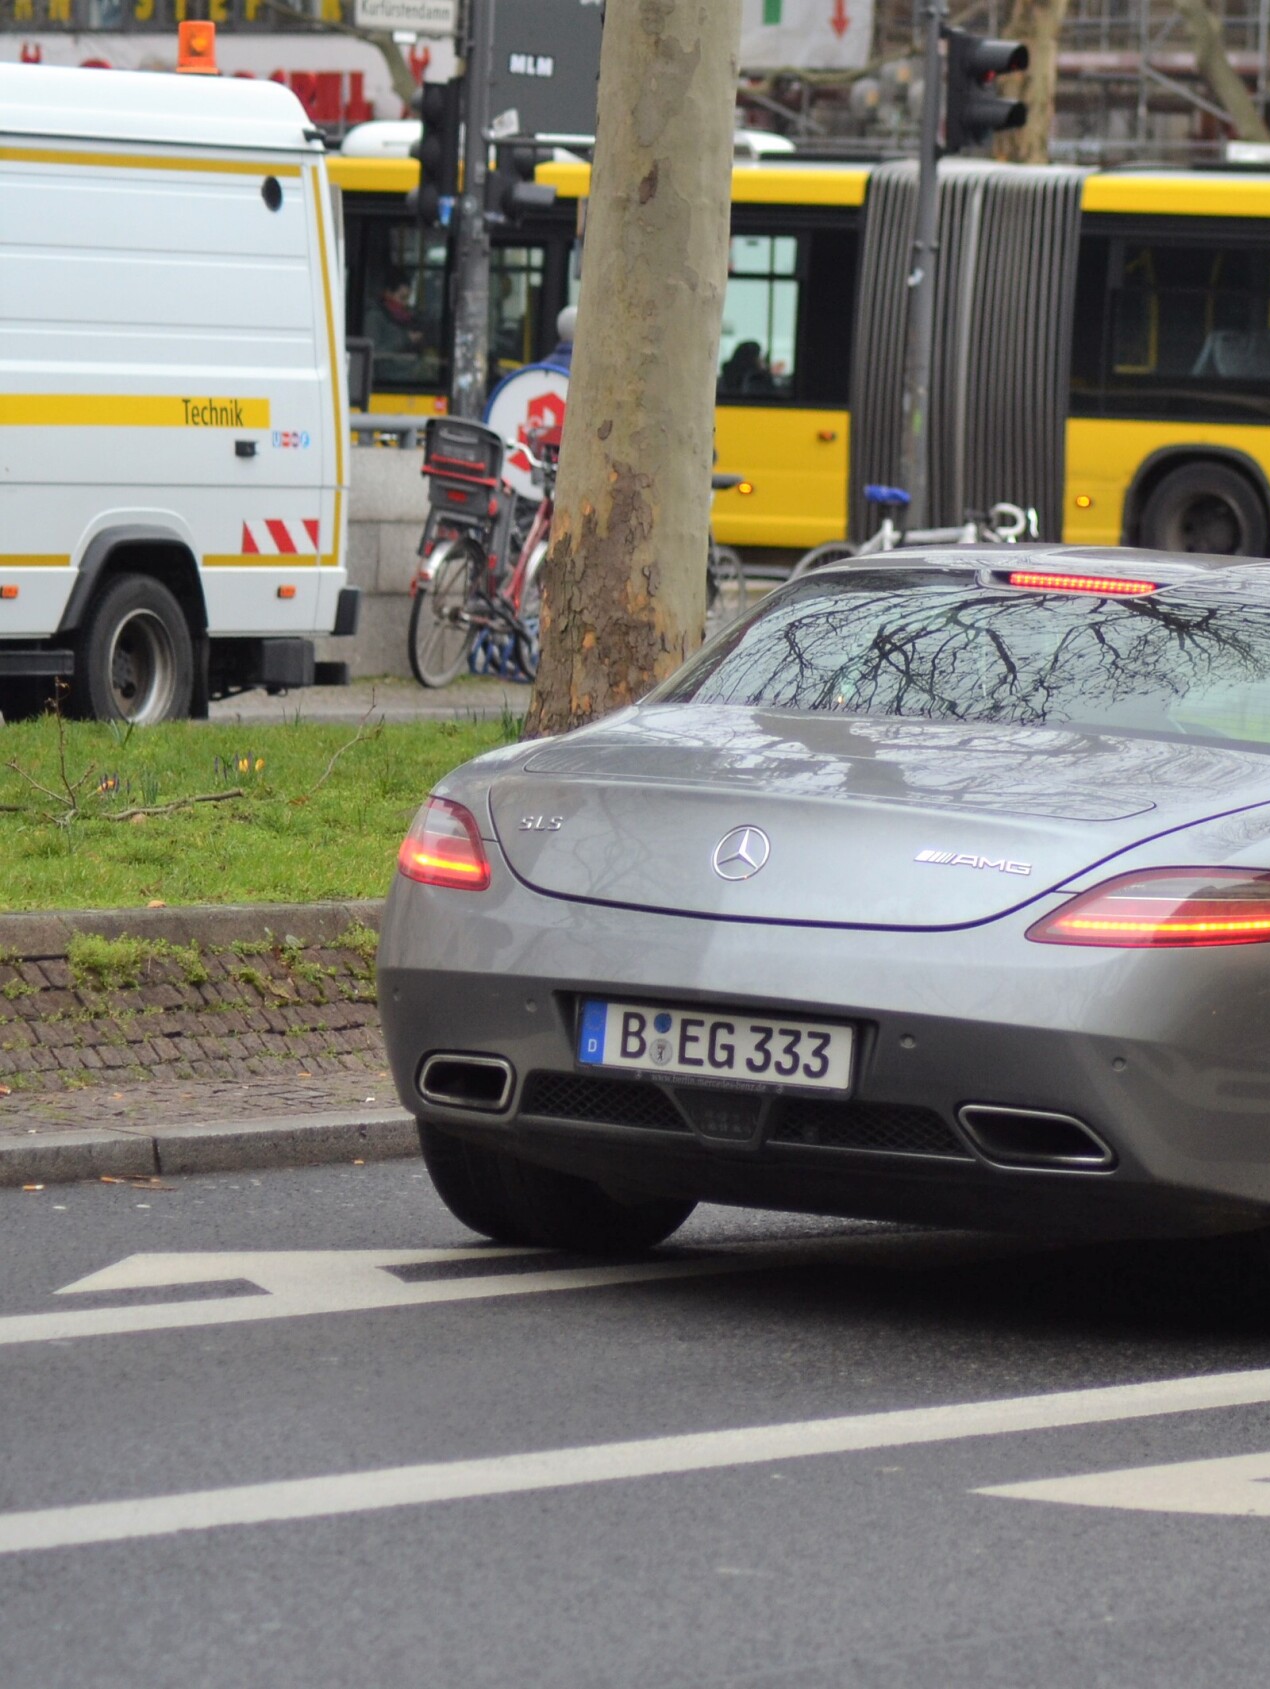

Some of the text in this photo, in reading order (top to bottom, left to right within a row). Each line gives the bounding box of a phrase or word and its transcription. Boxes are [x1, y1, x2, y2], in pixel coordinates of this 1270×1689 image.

[182, 398, 244, 427] Technik
[518, 815, 564, 832] SLS
[951, 854, 1033, 876] AMG
[620, 1011, 832, 1079] B EG 333
